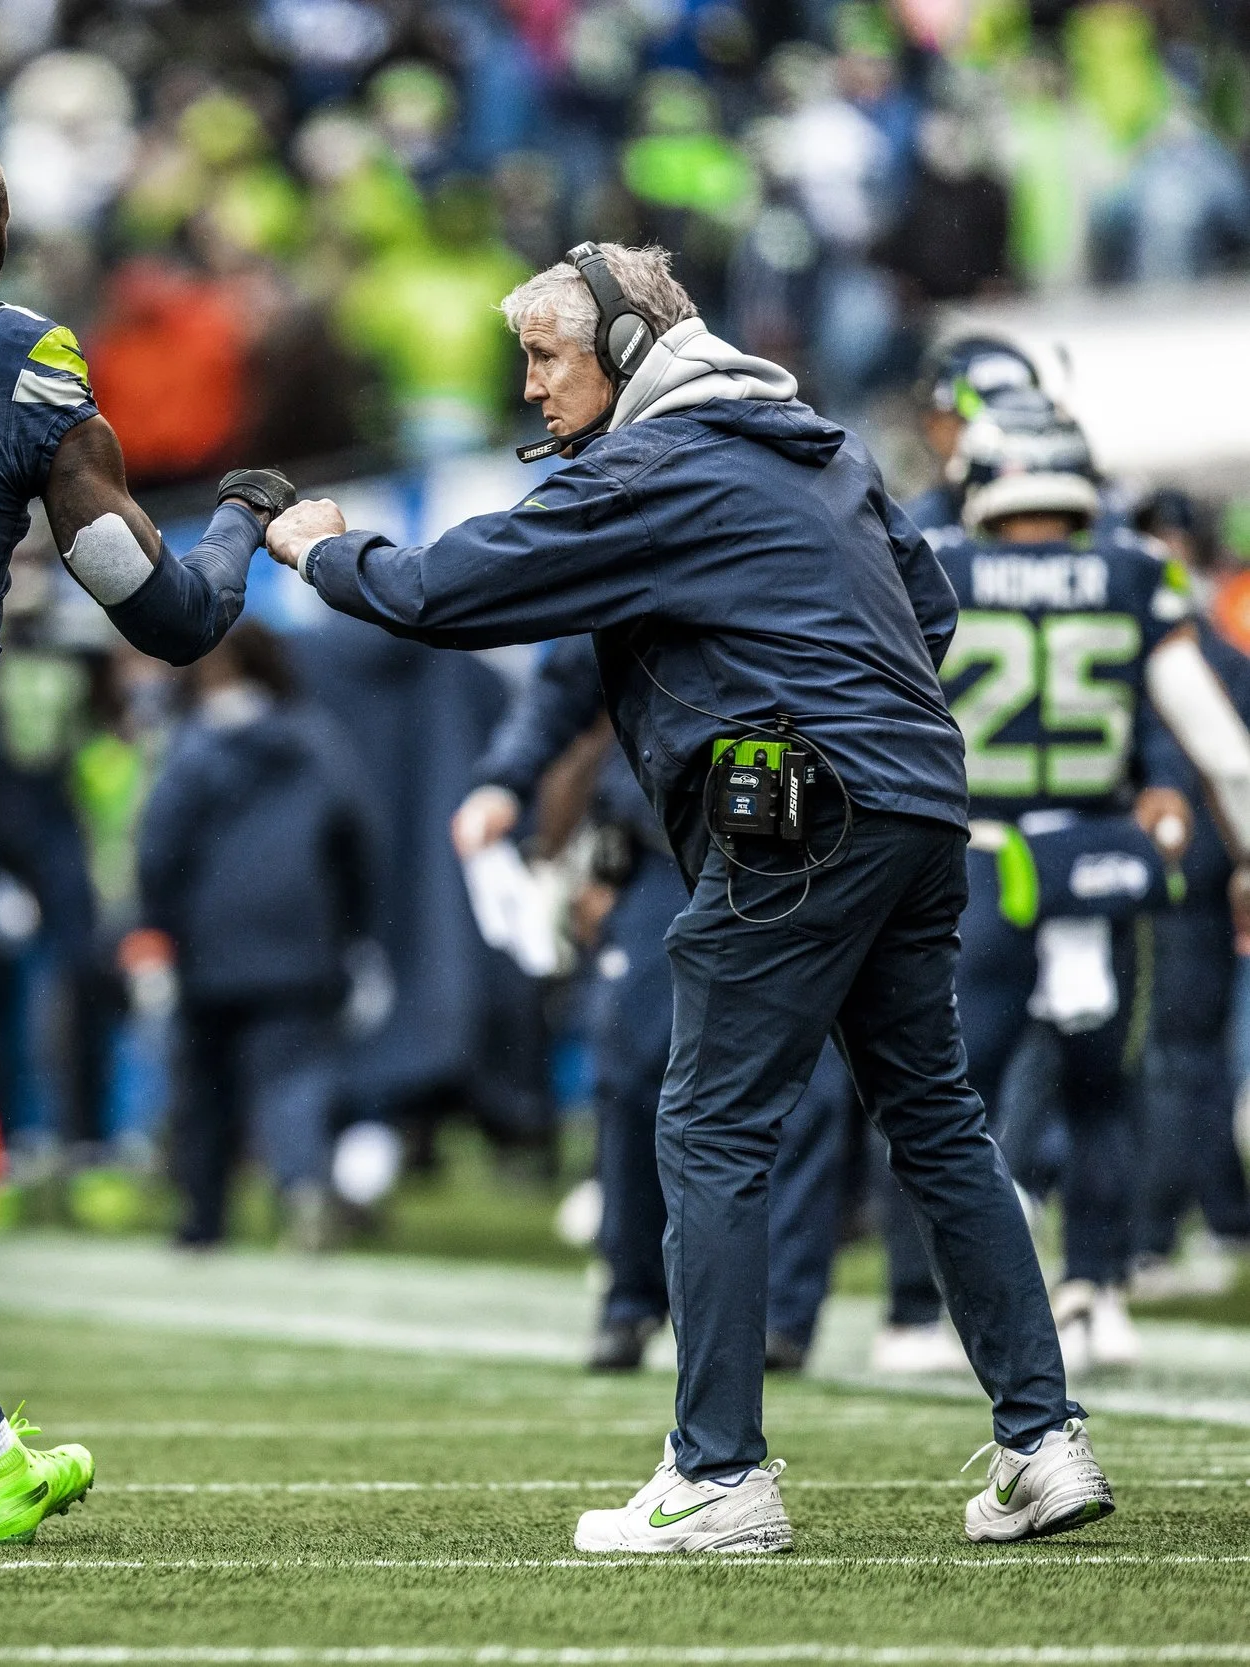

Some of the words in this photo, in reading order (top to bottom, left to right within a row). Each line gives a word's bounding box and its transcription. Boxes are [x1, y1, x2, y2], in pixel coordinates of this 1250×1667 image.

[619, 321, 645, 369] BOSE
[521, 442, 556, 460] BOSE
[939, 610, 1142, 797] 25
[789, 768, 799, 827] BOSE
